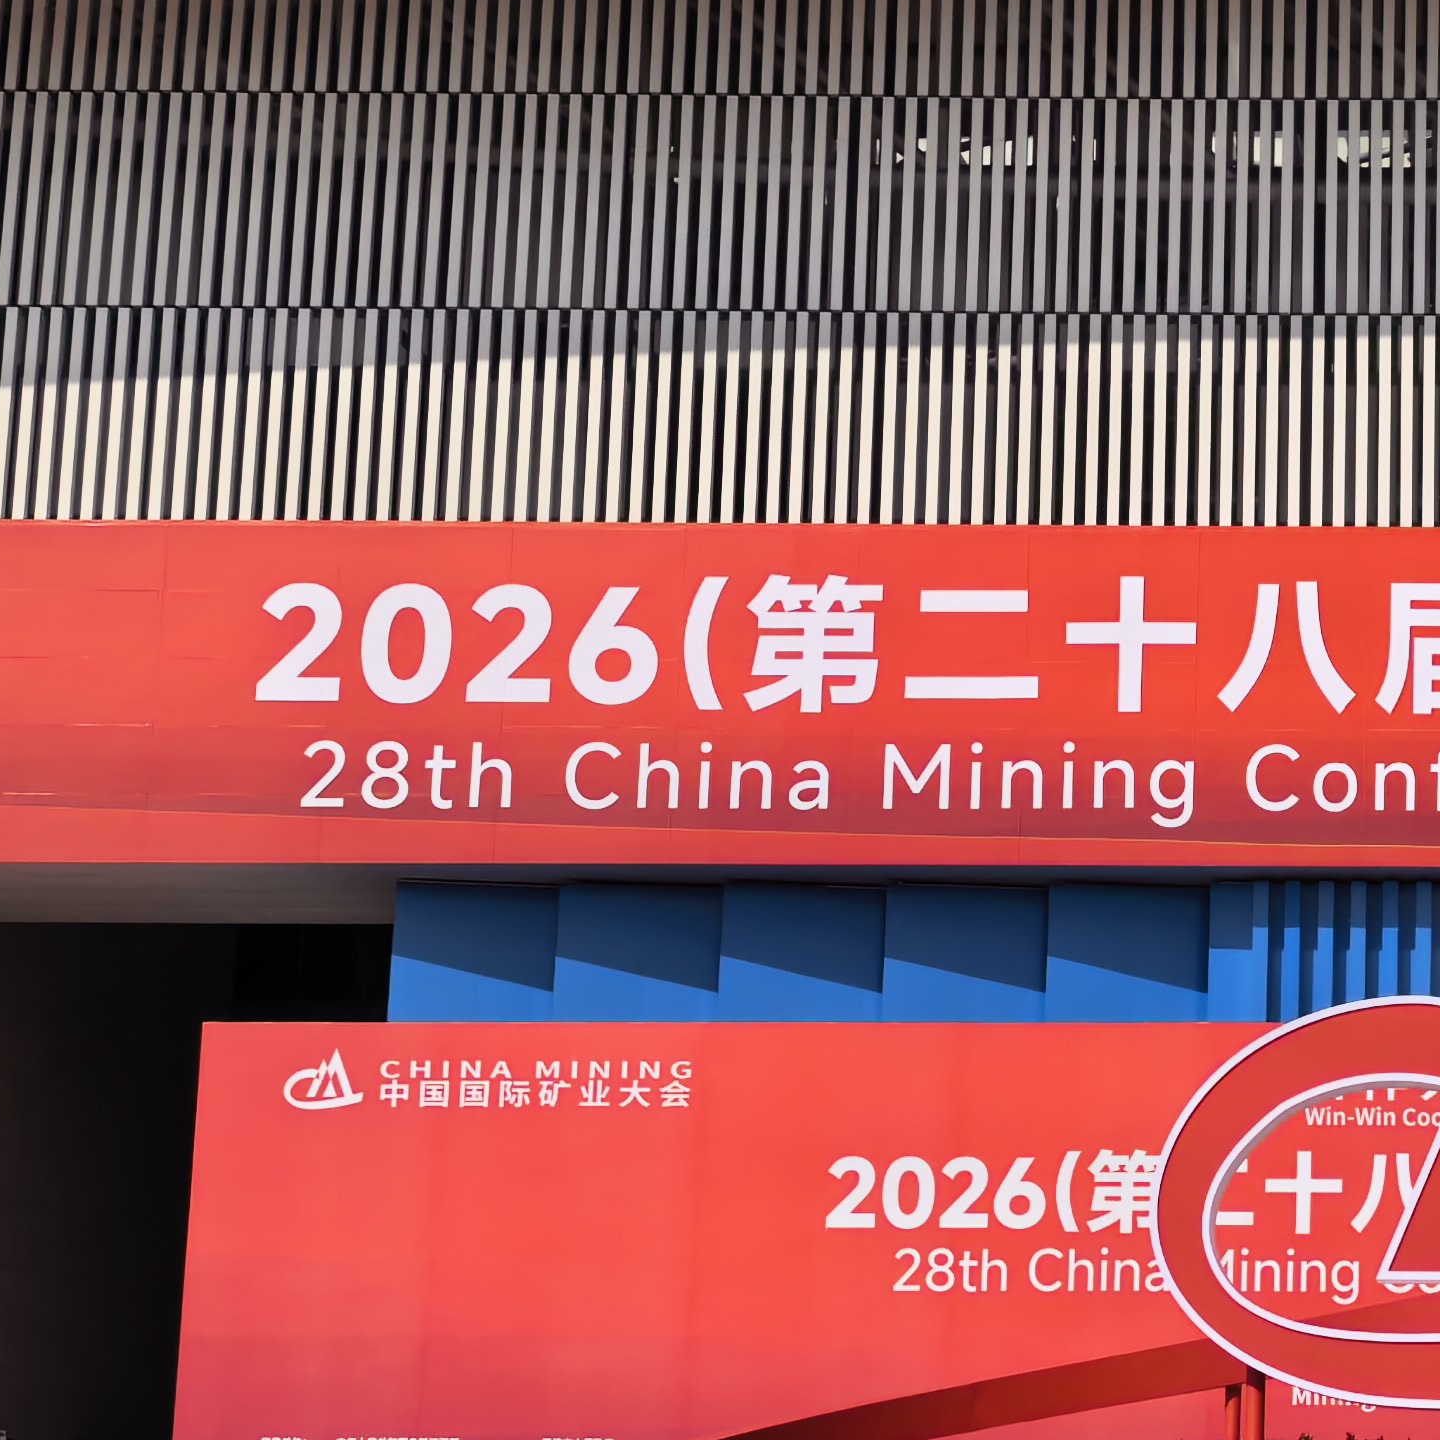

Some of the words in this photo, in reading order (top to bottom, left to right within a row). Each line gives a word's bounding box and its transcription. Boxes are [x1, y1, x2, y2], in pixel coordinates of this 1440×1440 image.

[301, 740, 511, 809] 28th
[566, 742, 829, 810] China
[883, 742, 1194, 827] Mining
[380, 1061, 511, 1078] CHINA
[536, 1061, 691, 1084] MINING
[380, 1077, 690, 1107] 中国国际矿业大会
[1305, 1106, 1395, 1126] Win-Win
[893, 1248, 1007, 1292] 28th
[1027, 1247, 1167, 1293] China
